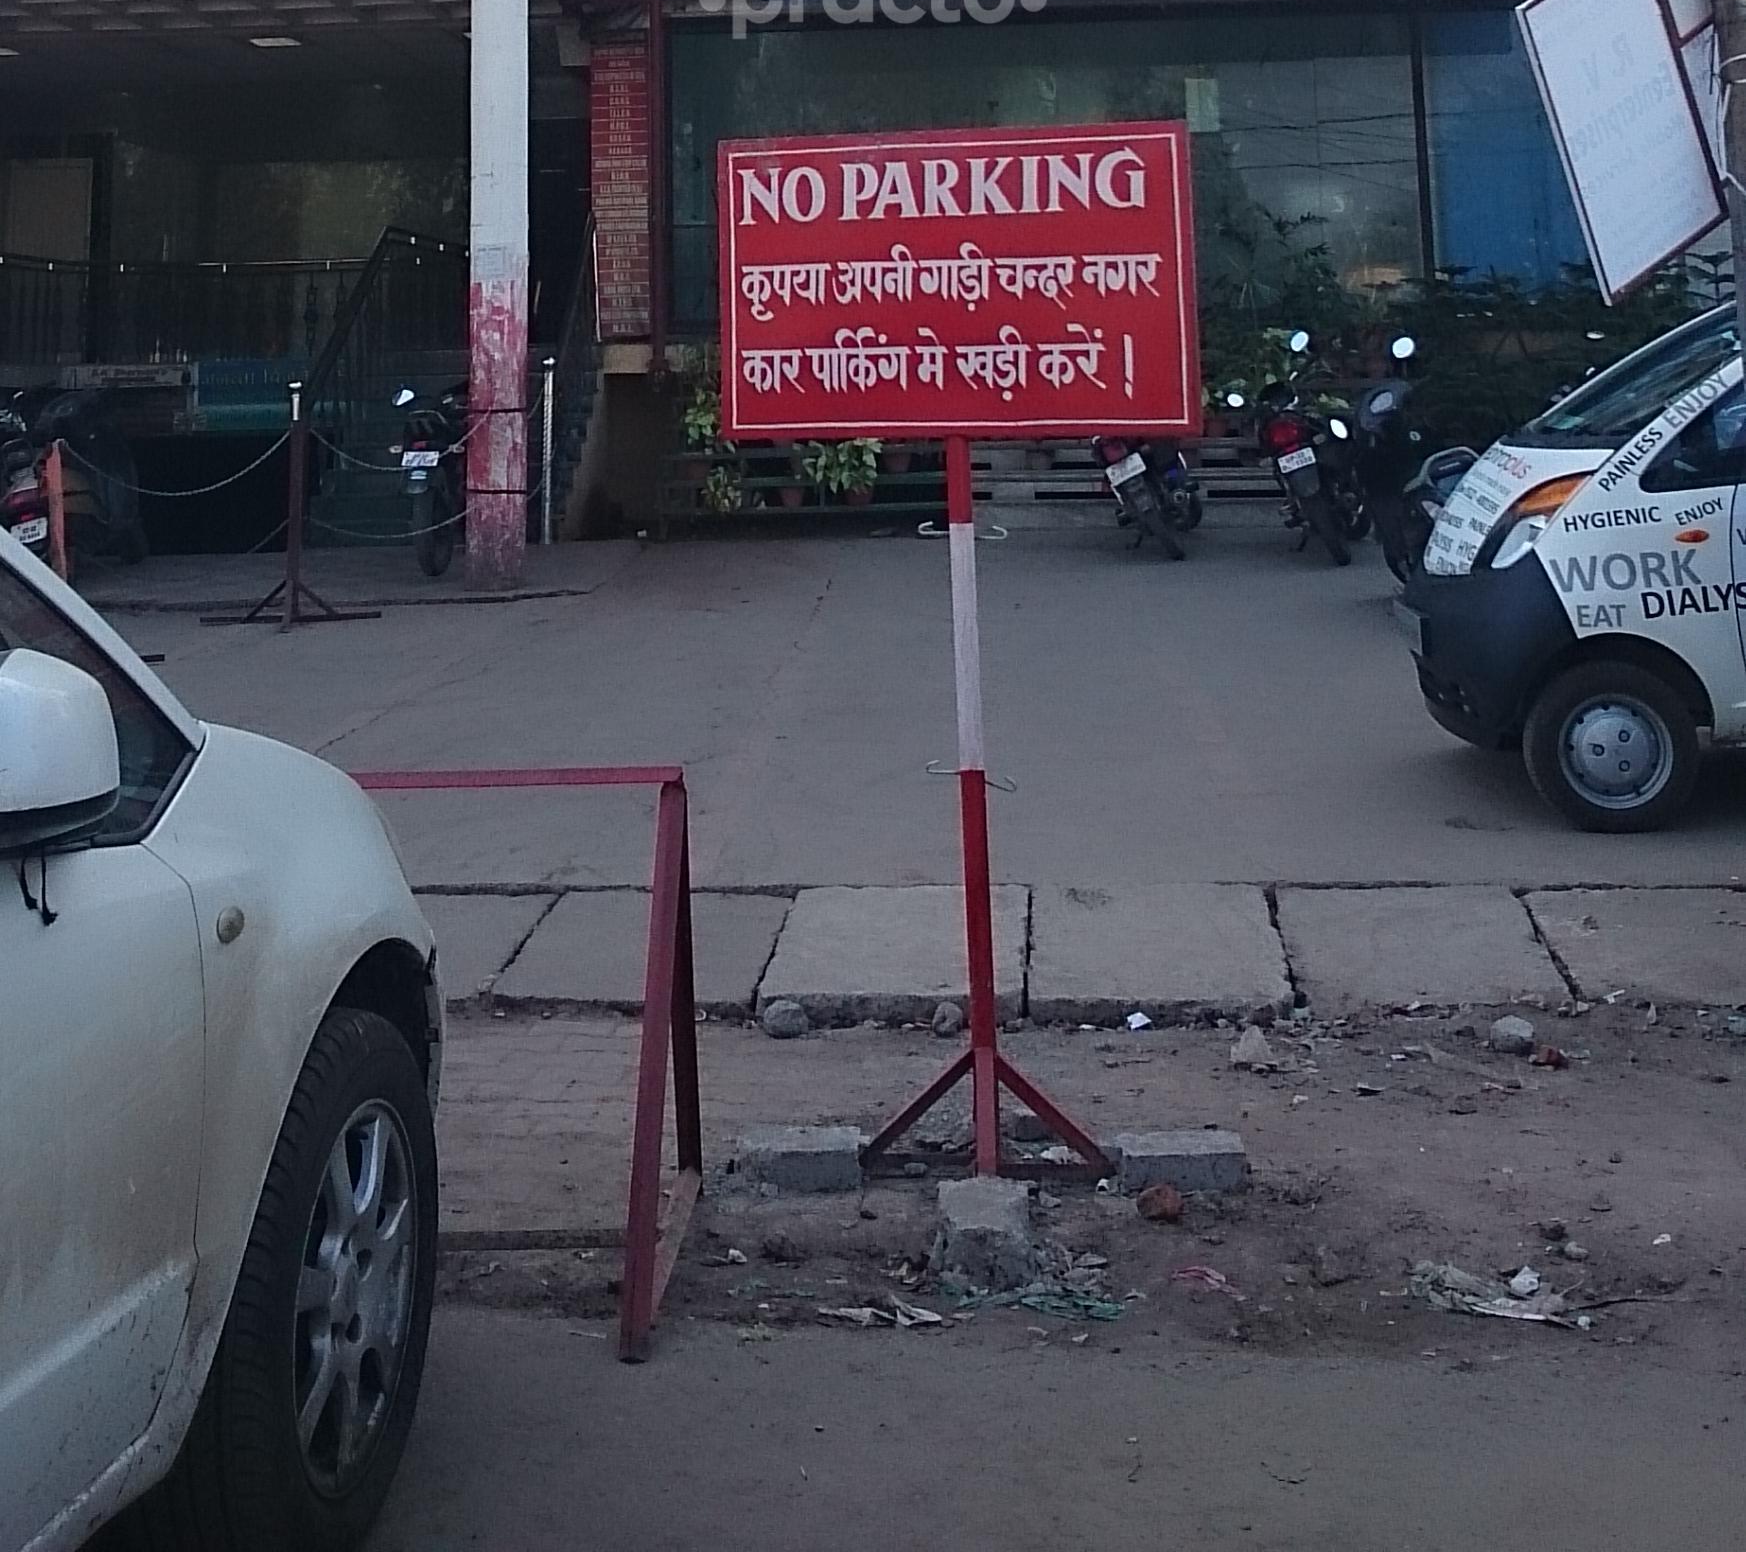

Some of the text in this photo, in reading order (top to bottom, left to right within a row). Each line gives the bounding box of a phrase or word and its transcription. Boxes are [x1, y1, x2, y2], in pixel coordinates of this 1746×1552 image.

[737, 147, 1147, 226] NO PARKING
[741, 261, 831, 321] कृपया
[833, 244, 918, 304] अपनी
[1082, 252, 1163, 298] नगर
[742, 349, 805, 393] कार
[1599, 427, 1663, 492] PAINLESS
[1662, 373, 1729, 429] ENJOY
[1563, 497, 1725, 533] HYGIENIC ENJOY
[1550, 549, 1702, 593] WORK
[1576, 604, 1626, 629] EAT
